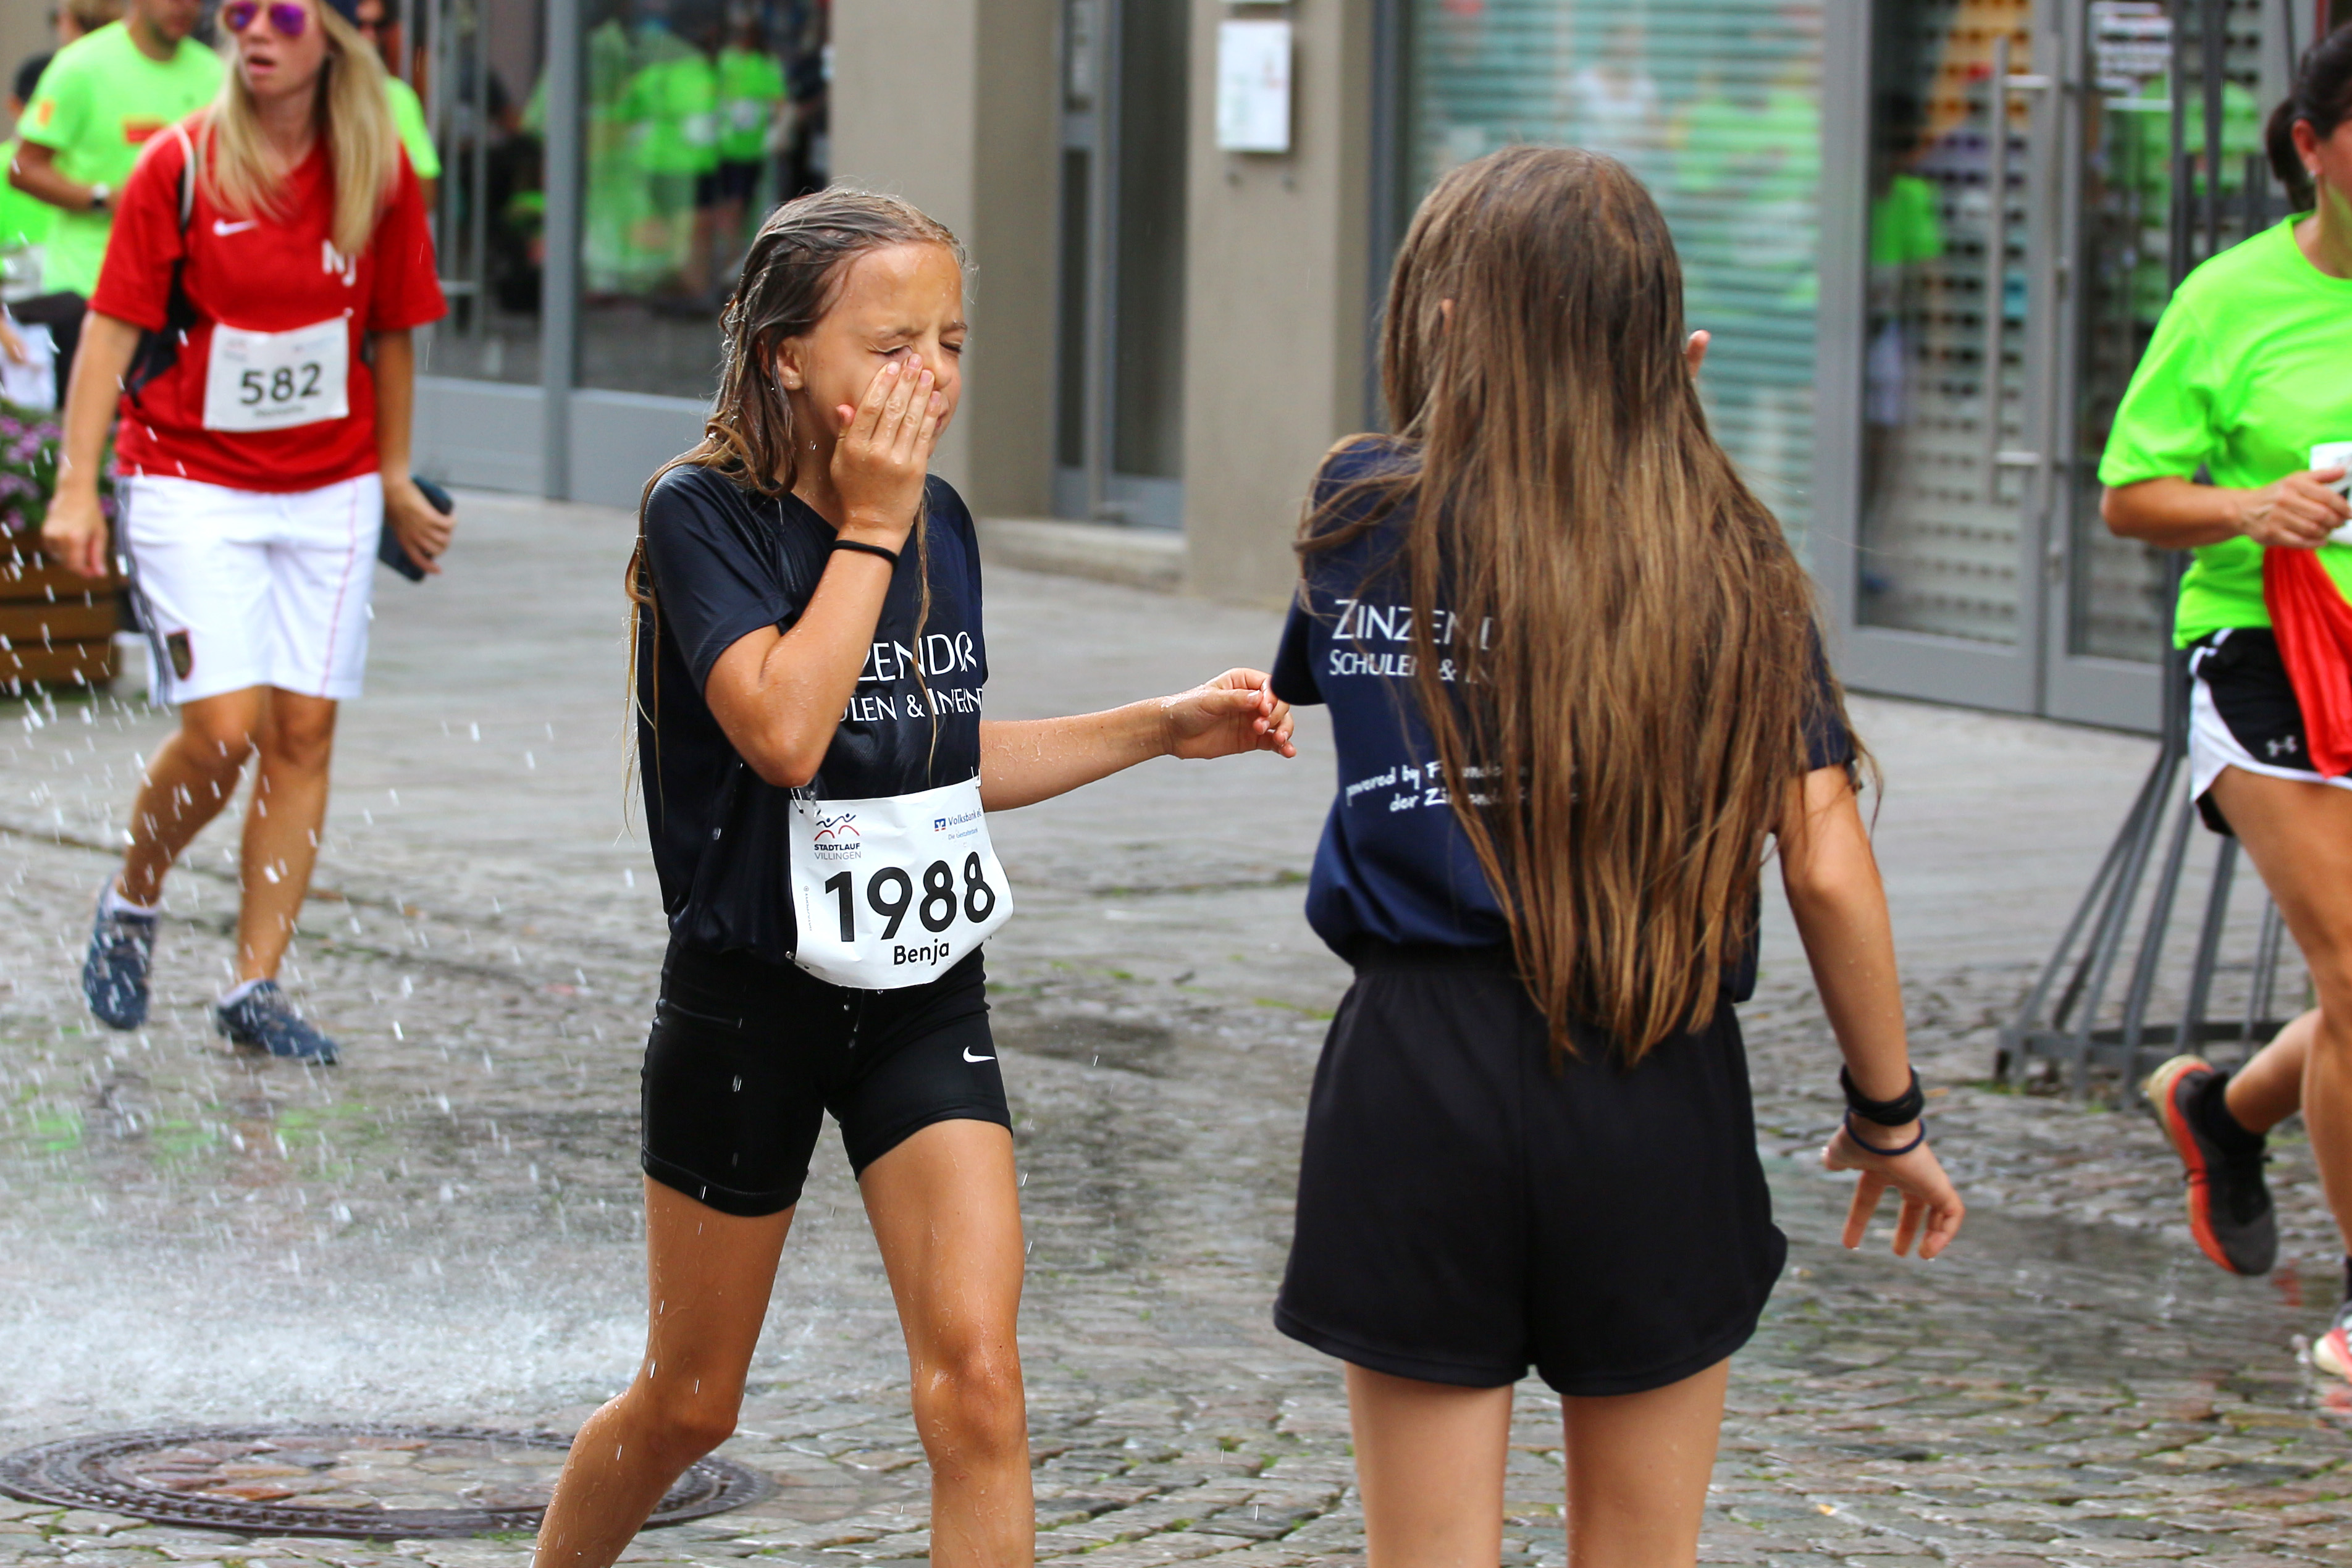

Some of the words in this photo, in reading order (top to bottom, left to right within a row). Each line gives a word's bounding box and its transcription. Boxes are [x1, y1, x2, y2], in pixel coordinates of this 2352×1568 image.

[240, 361, 321, 405] 582
[1438, 658, 1457, 682] &
[906, 694, 926, 718] &
[1401, 764, 1420, 790] by
[814, 843, 860, 851] STADTLAUF
[814, 851, 862, 860] VILLINGEN
[825, 851, 996, 943] 1988
[893, 938, 950, 966] Benja
